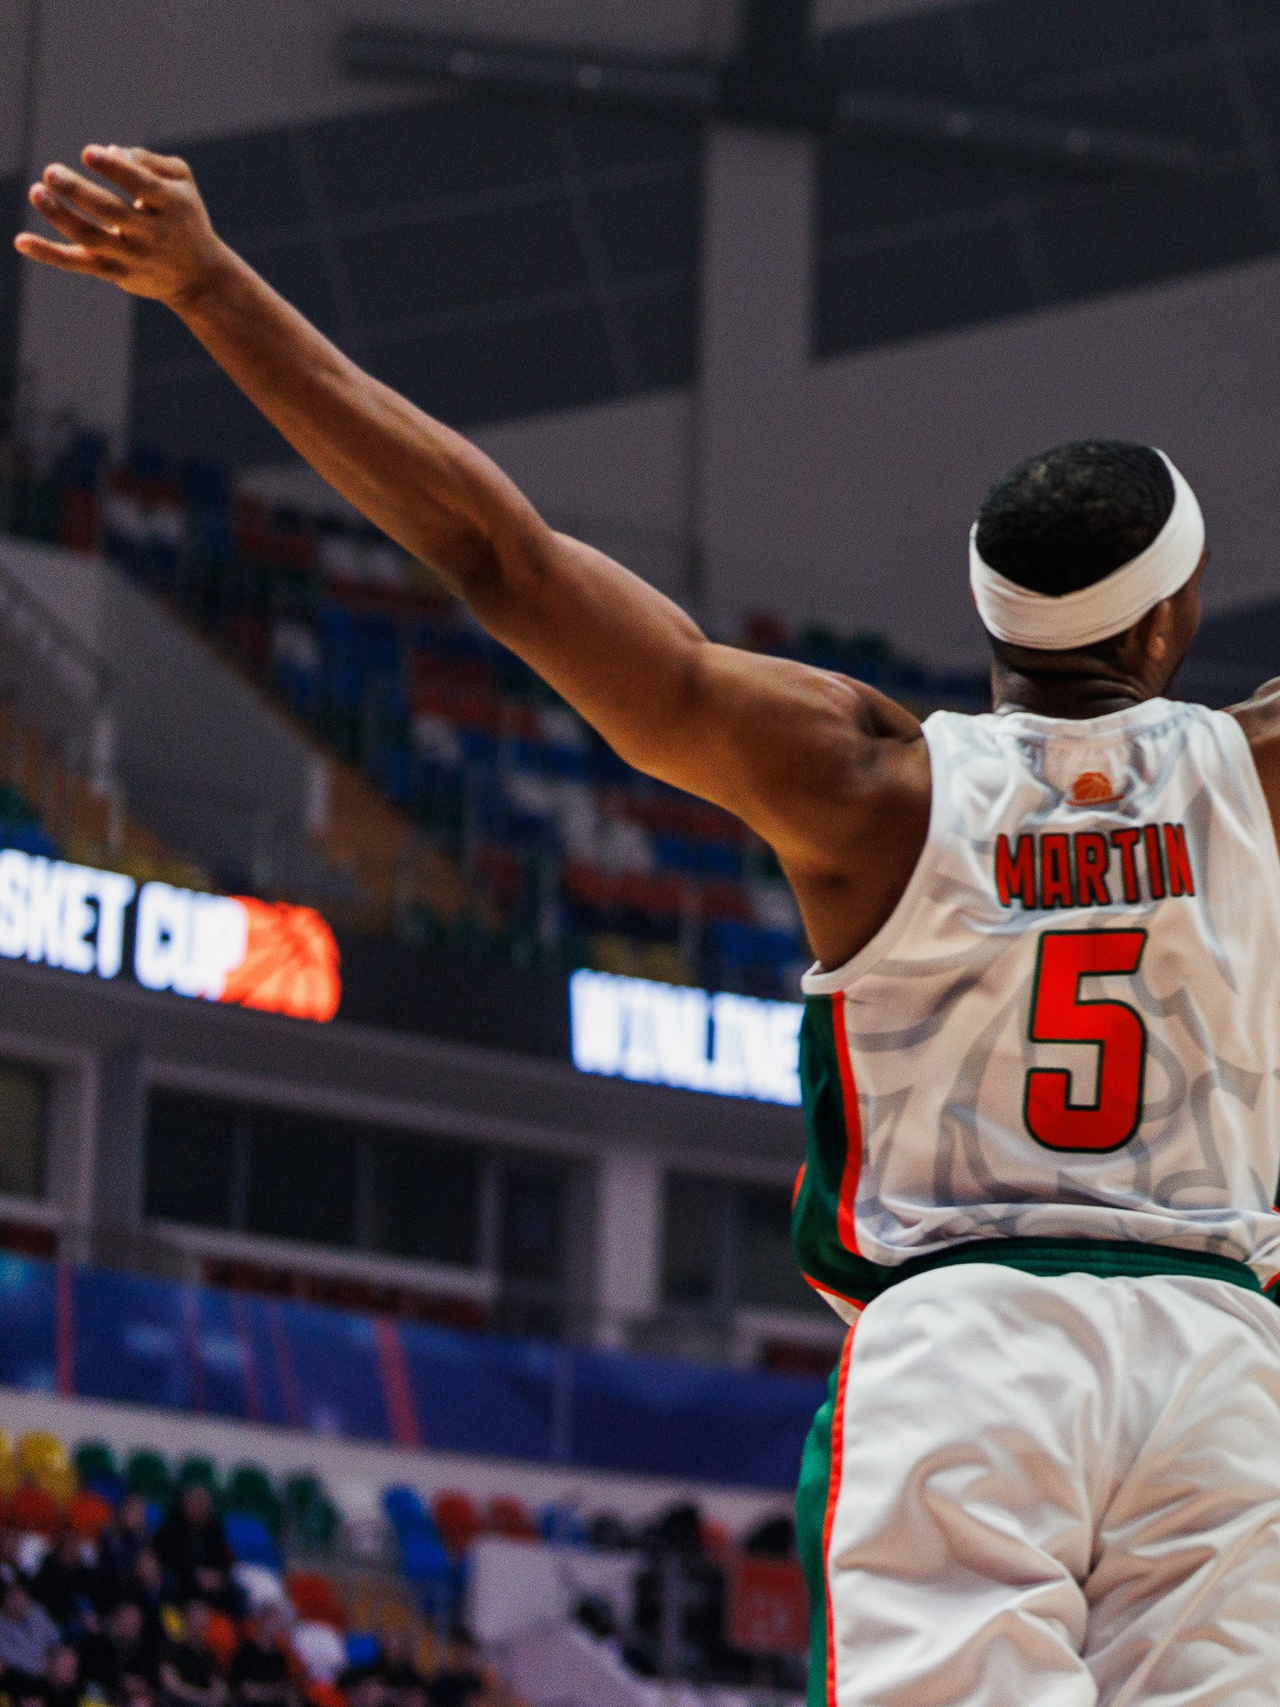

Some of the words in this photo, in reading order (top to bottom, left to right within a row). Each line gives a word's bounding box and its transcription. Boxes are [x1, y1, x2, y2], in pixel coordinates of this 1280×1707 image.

[994, 822, 1196, 909] MARTIN
[136, 881, 247, 1000] CUP
[570, 969, 804, 1105] WINLINE
[1023, 928, 1148, 1154] 5
